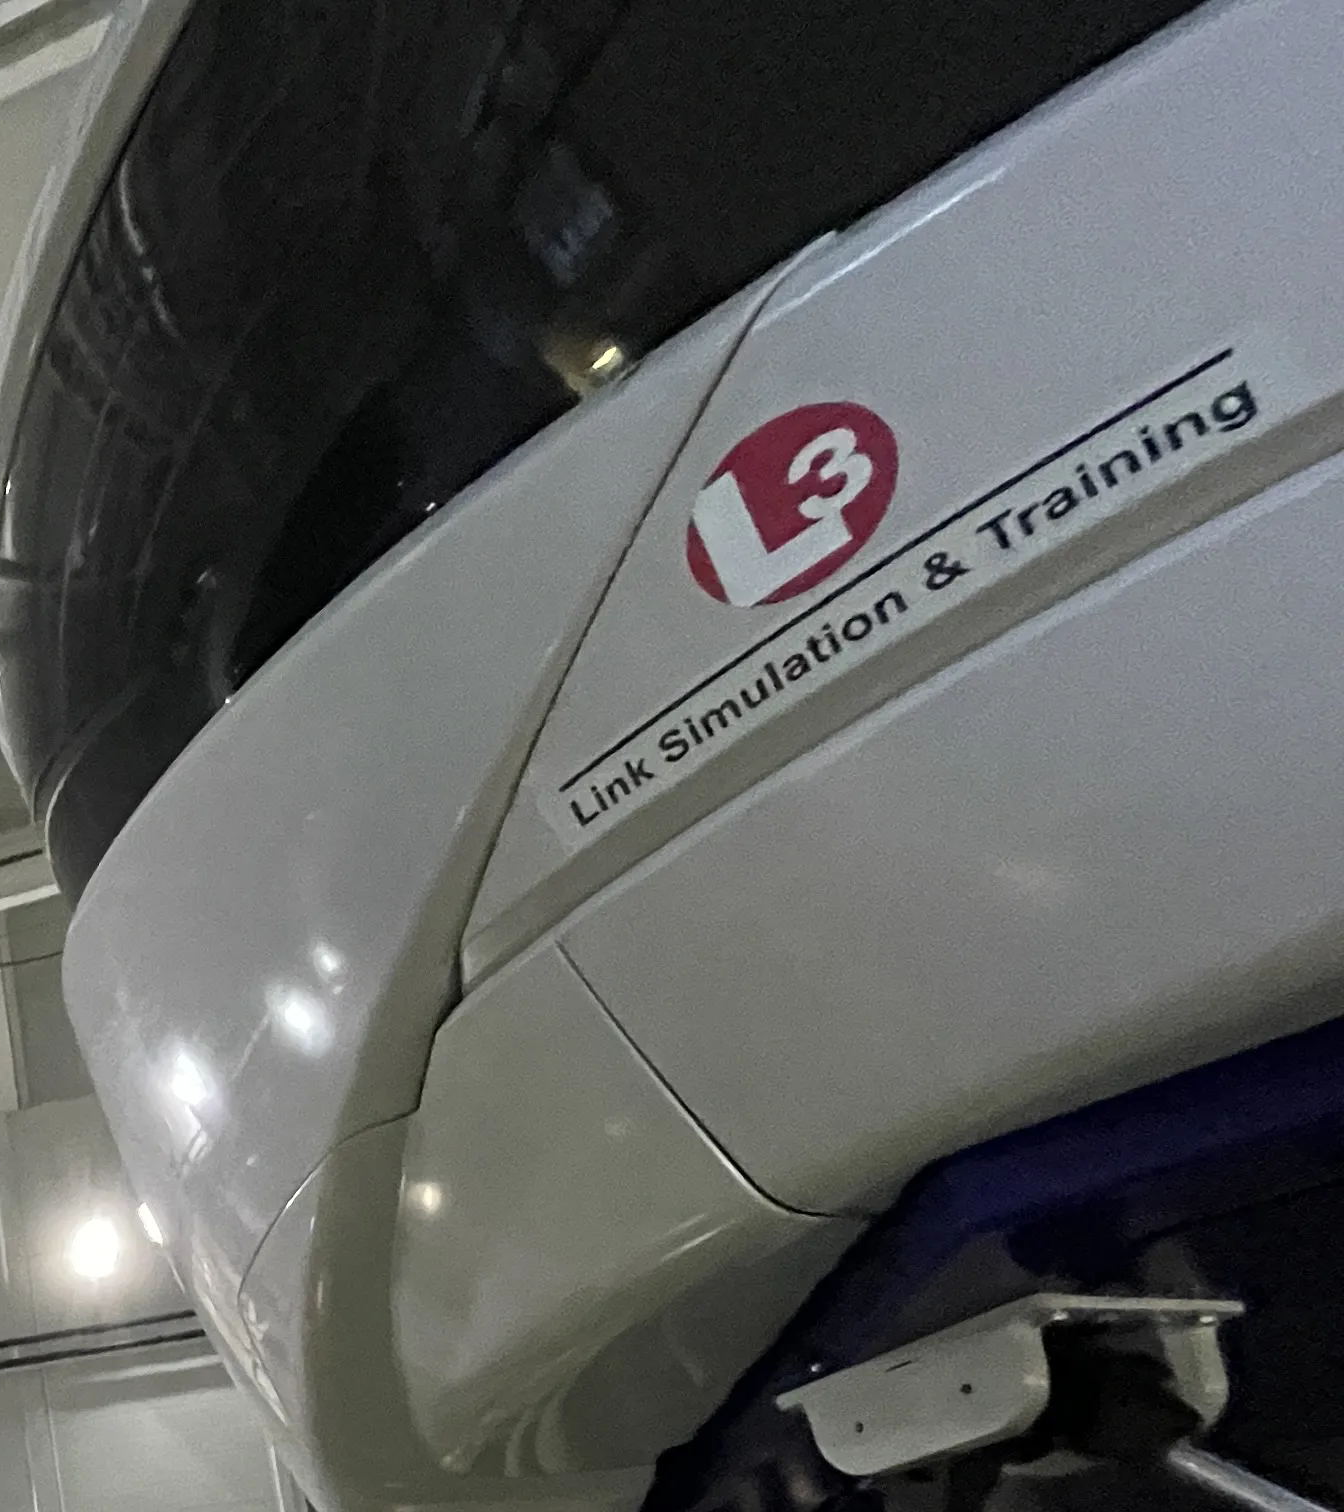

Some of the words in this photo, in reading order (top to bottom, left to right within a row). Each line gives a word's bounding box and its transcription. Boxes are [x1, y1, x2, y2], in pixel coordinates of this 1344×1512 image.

[570, 757, 656, 826] Link
[658, 587, 908, 763] Simulation
[923, 551, 972, 591] &
[975, 379, 1258, 550] Training
[691, 426, 873, 607] L3
